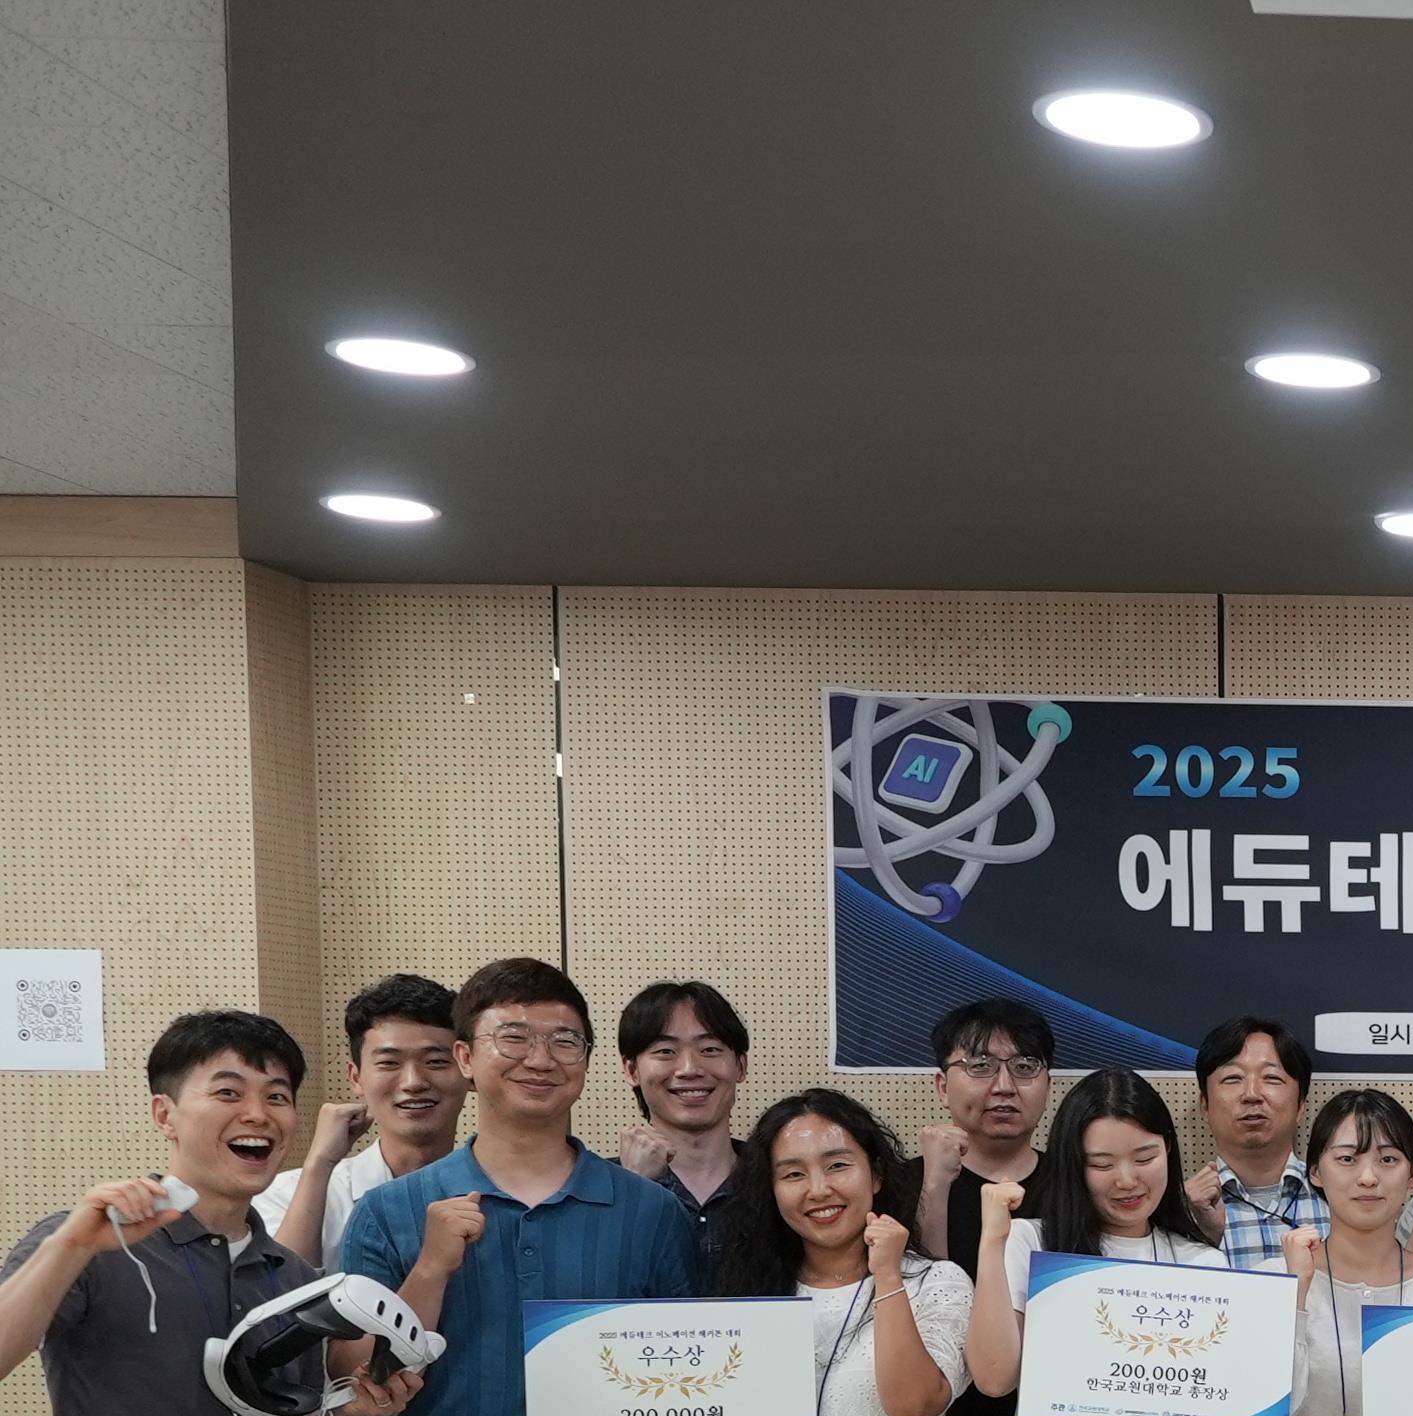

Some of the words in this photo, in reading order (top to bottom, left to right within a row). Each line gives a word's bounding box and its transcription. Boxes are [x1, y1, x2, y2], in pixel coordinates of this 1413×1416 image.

[902, 754, 939, 784] AI
[1132, 745, 1301, 799] 2025
[1131, 1304, 1195, 1329] 우수상
[637, 1344, 705, 1367] 우수상
[1110, 1362, 1207, 1385] 200,000원
